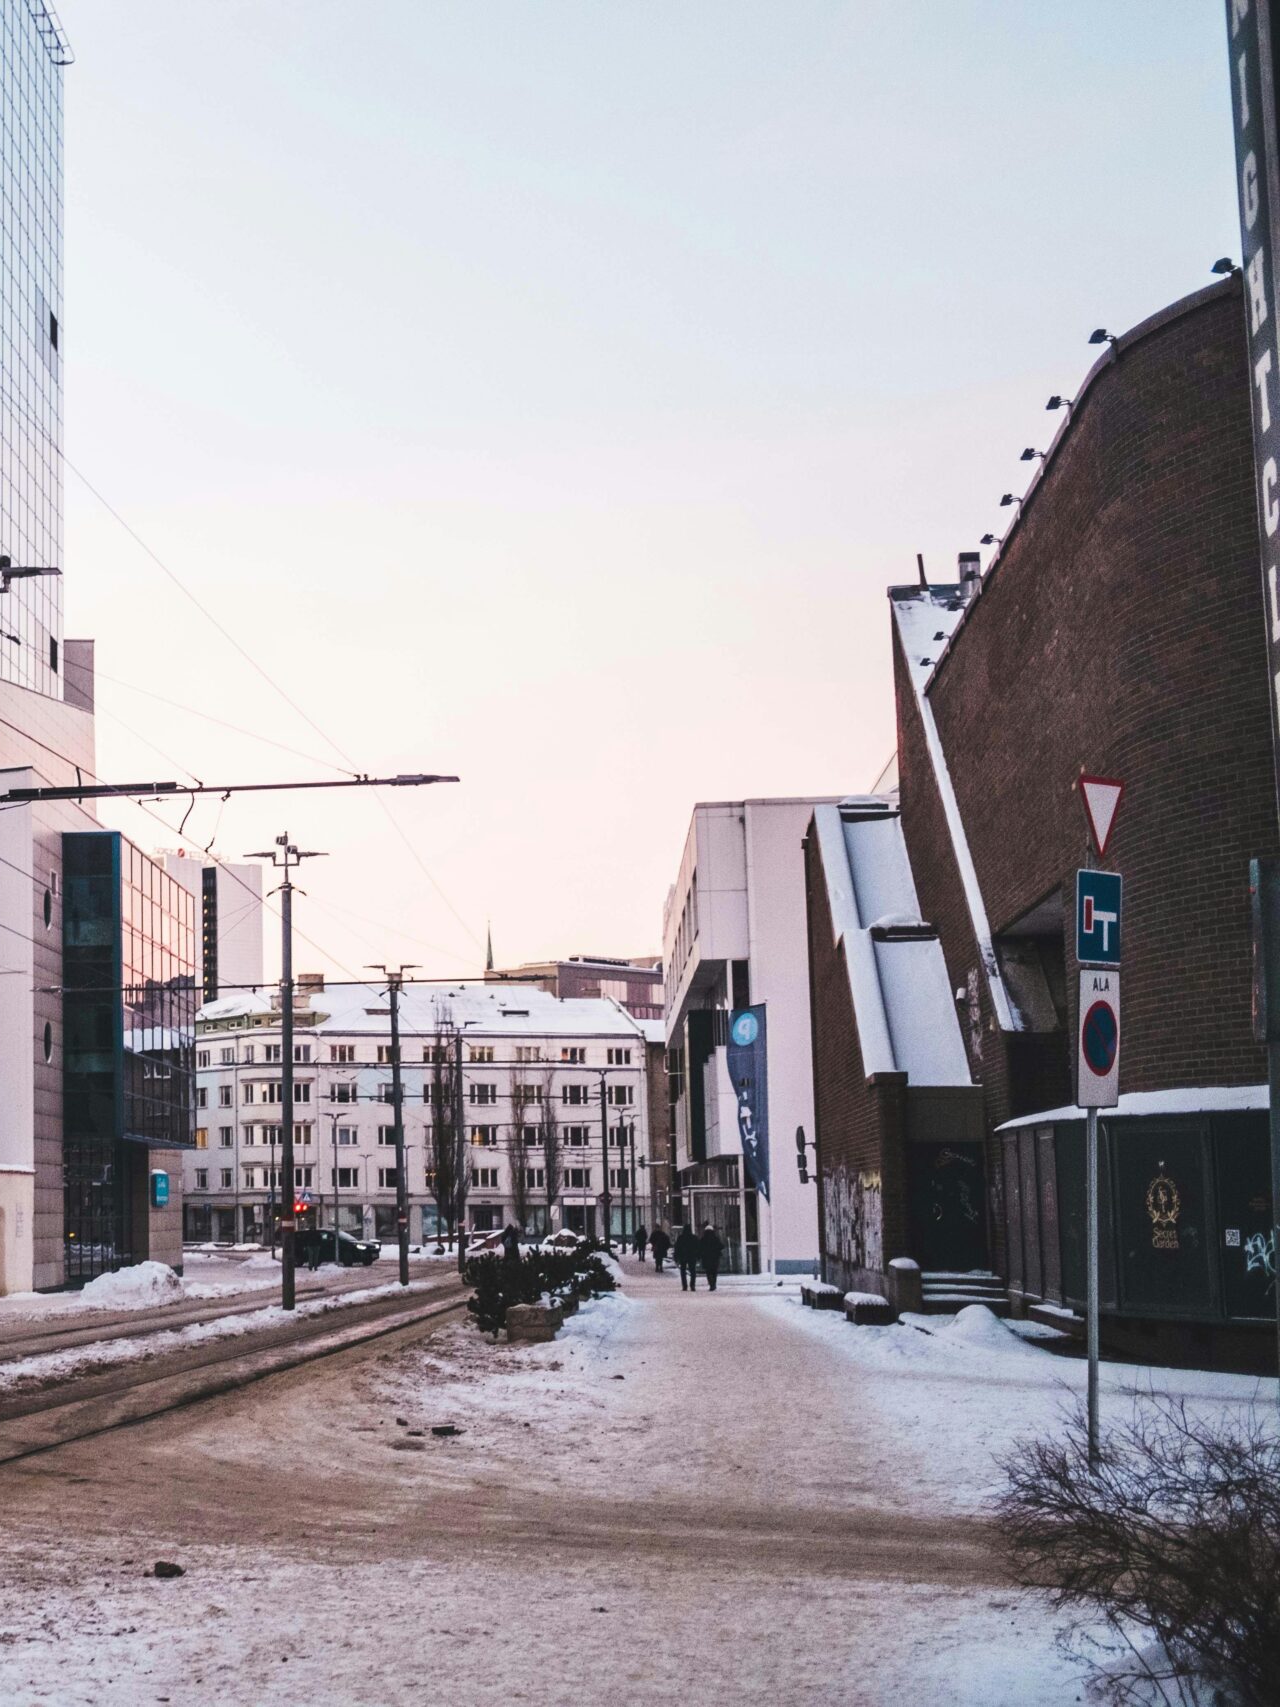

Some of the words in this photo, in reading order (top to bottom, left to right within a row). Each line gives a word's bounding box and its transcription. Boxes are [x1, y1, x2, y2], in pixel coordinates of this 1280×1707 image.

[1093, 976, 1110, 992] ALA
[1153, 1227, 1177, 1239] Secret
[1152, 1236, 1179, 1248] Garden
